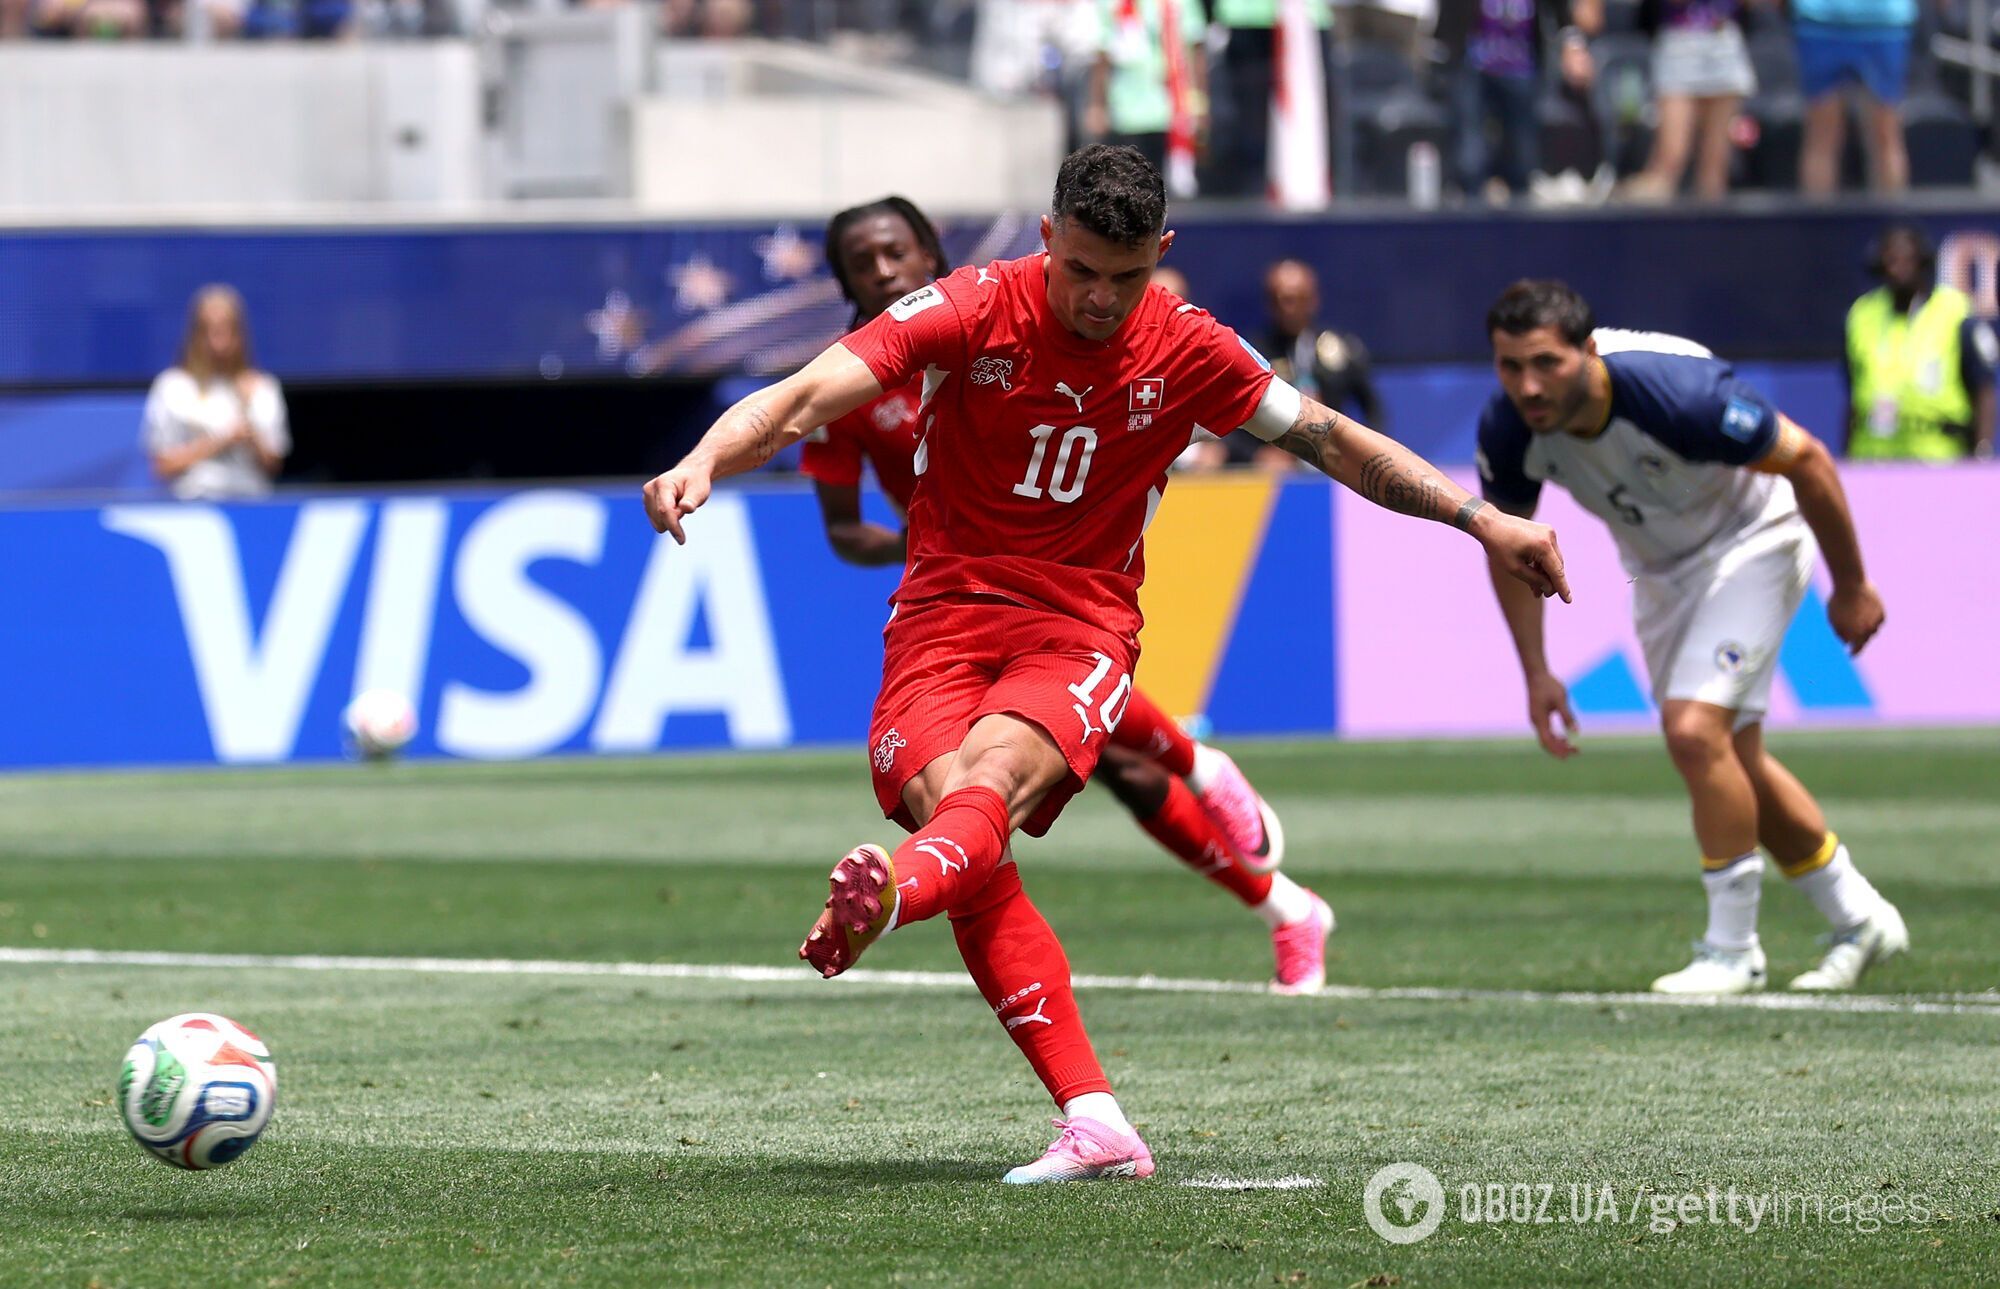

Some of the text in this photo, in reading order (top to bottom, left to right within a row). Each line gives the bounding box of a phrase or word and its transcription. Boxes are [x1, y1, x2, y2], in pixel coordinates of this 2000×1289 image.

[1013, 423, 1097, 504] 10
[1607, 484, 1643, 526] 5
[101, 488, 795, 763] VISA
[1067, 651, 1132, 734] 10
